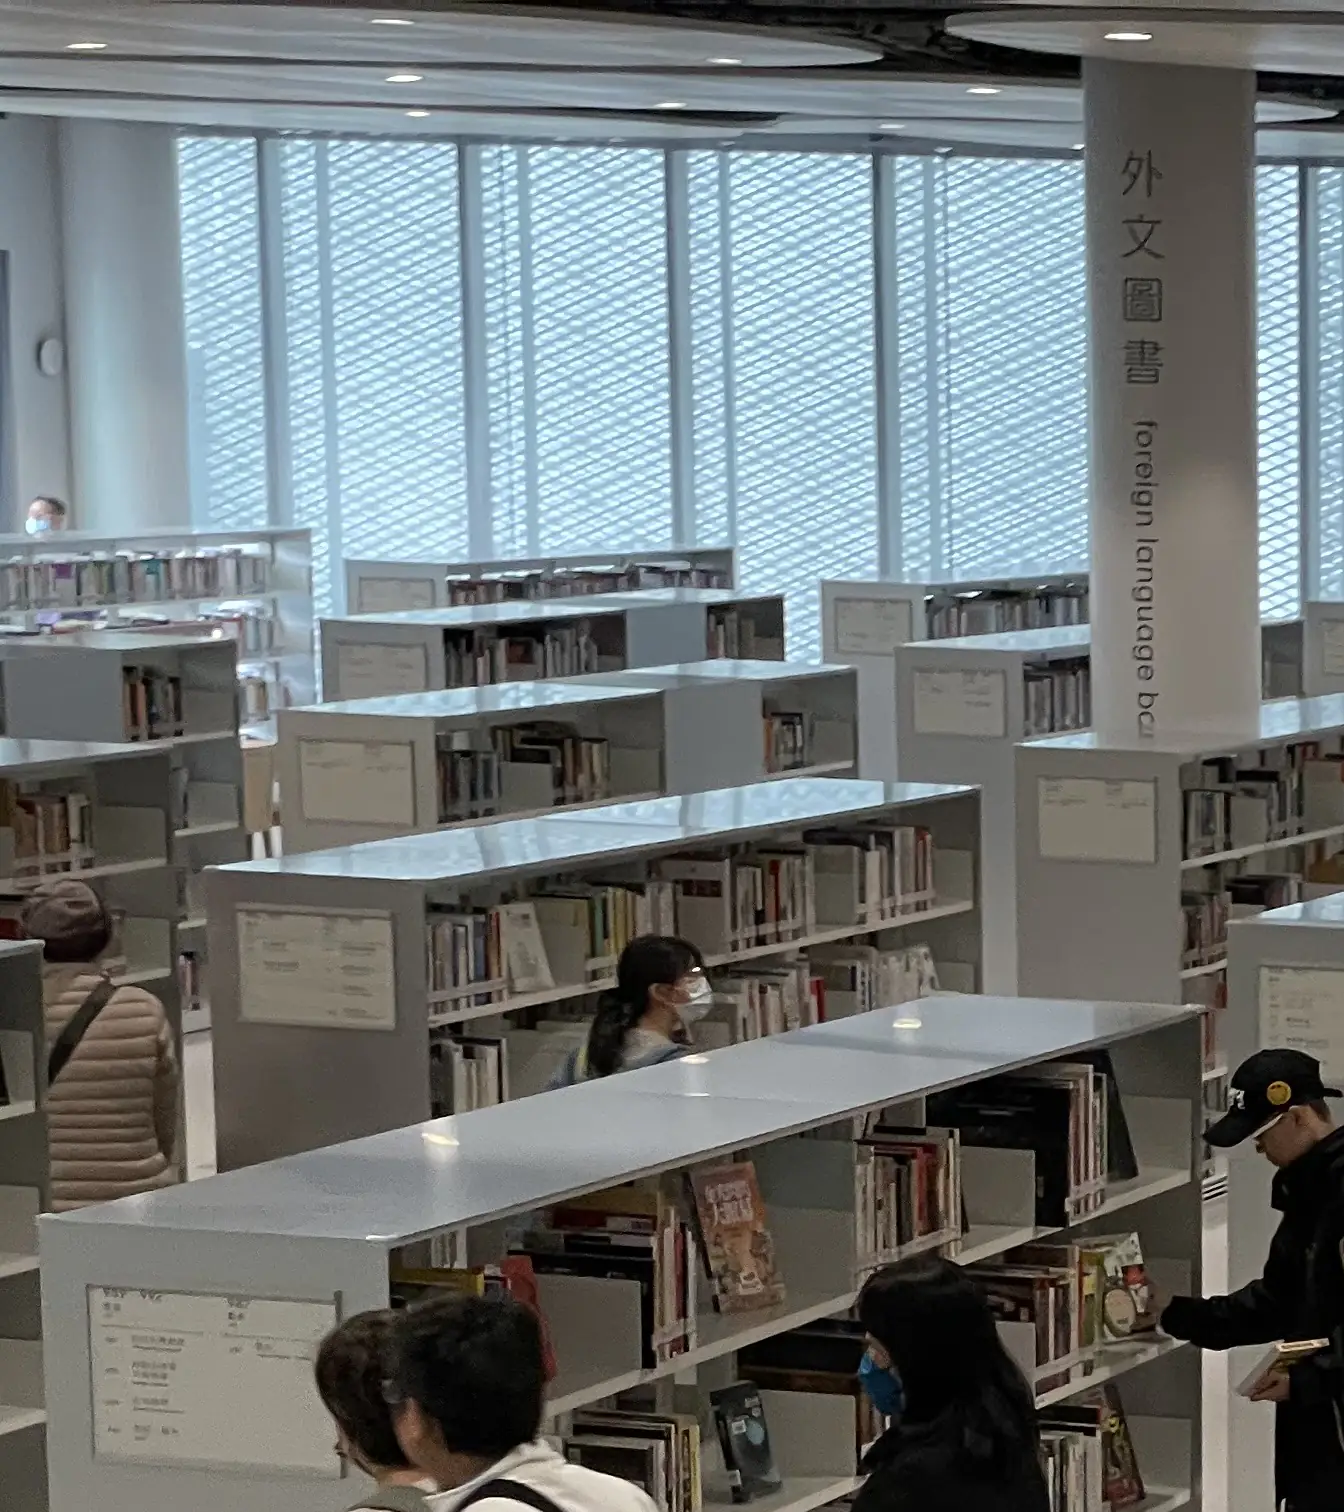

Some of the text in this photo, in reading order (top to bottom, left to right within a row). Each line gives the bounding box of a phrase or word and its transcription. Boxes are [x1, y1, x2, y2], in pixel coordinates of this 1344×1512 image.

[1120, 149, 1164, 385] 外文圖書
[1130, 420, 1158, 528] foreign
[1131, 537, 1160, 681] language
